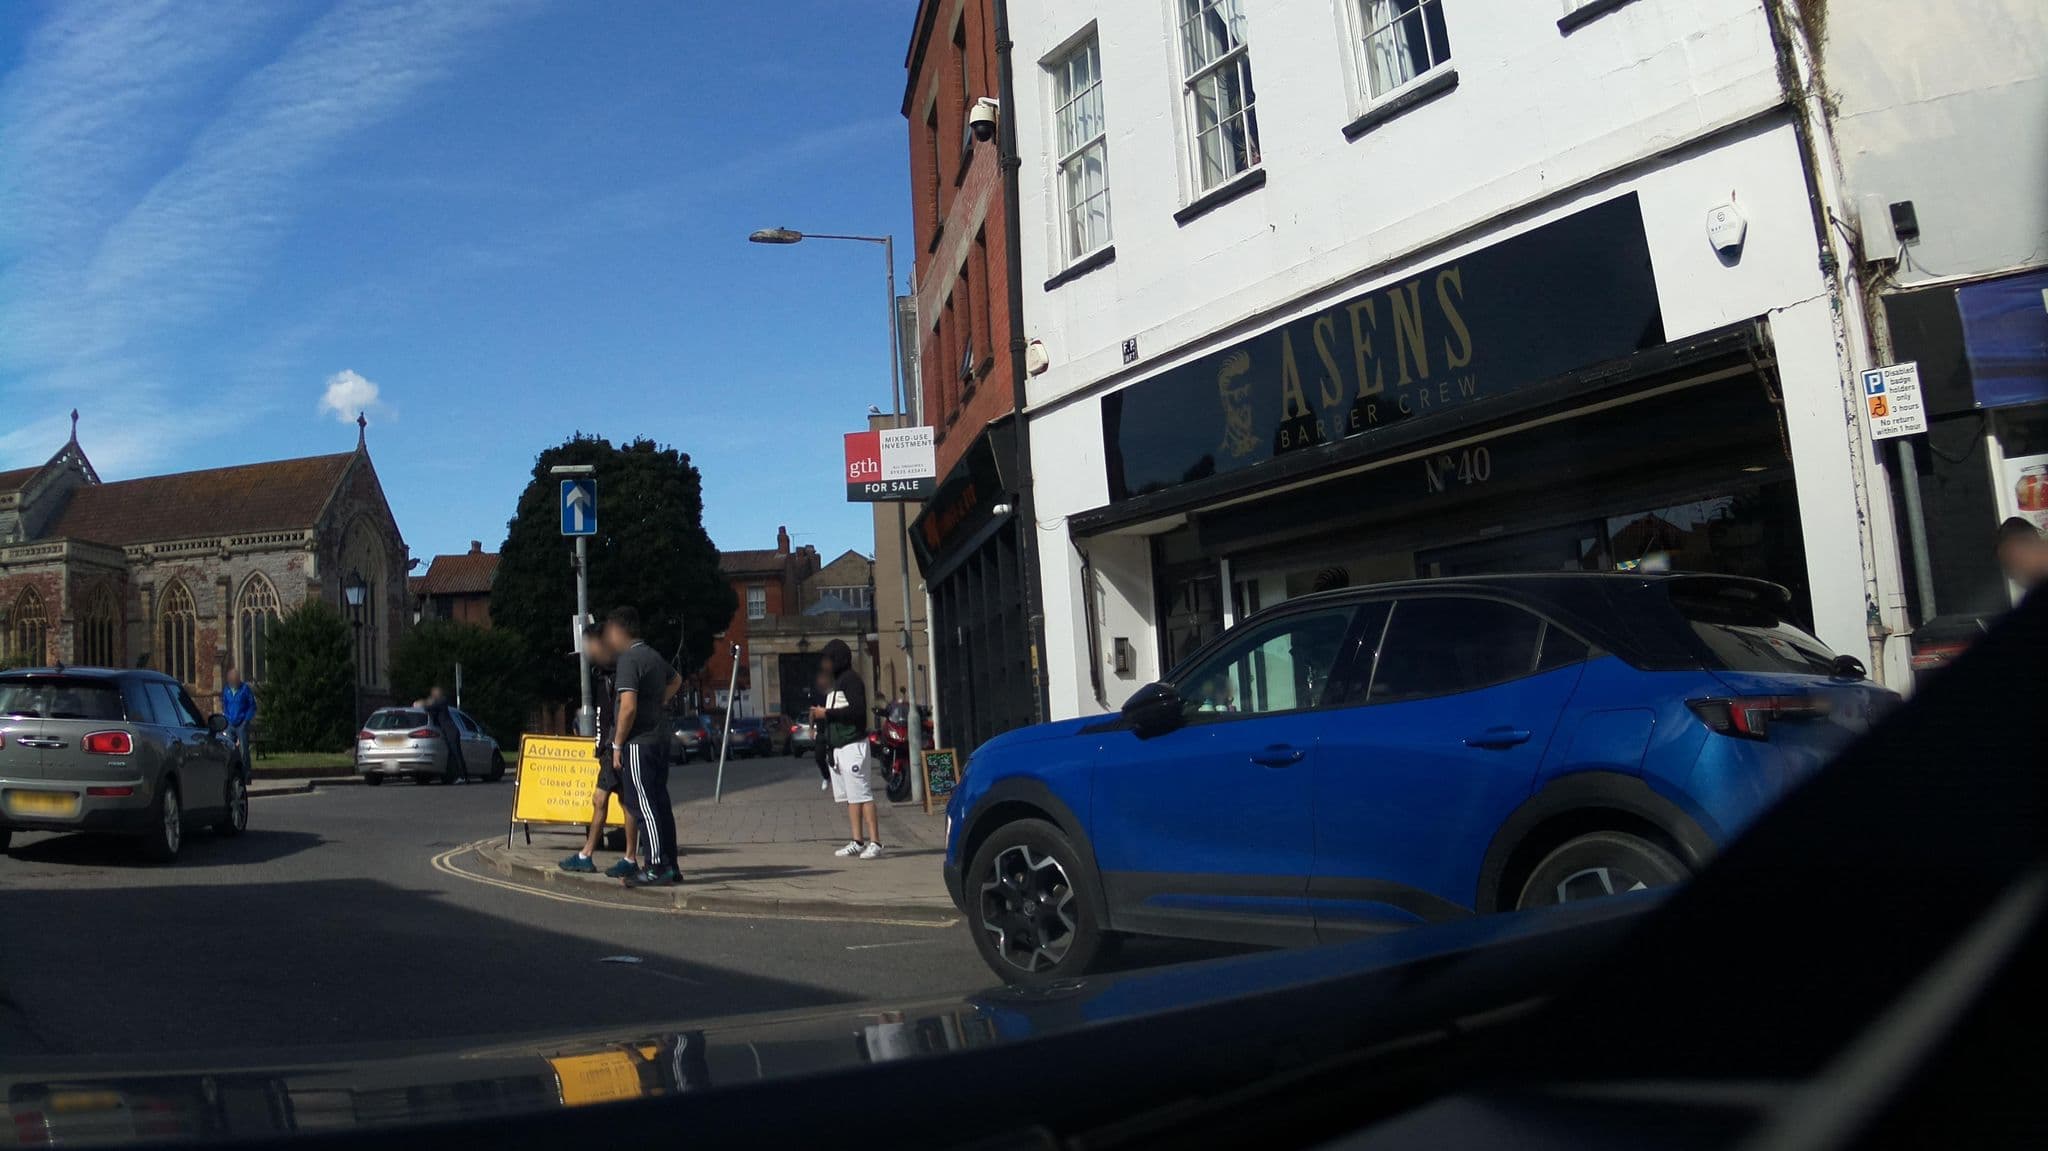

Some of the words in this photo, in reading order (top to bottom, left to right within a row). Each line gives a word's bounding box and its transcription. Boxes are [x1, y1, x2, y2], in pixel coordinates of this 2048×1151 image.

[1280, 266, 1472, 422] ASENS
[1884, 366, 1914, 377] Disabled
[1868, 374, 1881, 393] P
[1890, 376, 1911, 385] badge
[1889, 384, 1915, 393] holders
[1280, 404, 1377, 448] BARBER
[1399, 375, 1476, 414] CREW
[1899, 403, 1919, 411] hours
[1892, 416, 1914, 424] return
[1877, 427, 1897, 435] within
[882, 440, 932, 449] INVESTMENT
[850, 458, 878, 478] gth
[1458, 447, 1491, 484] 40
[865, 483, 887, 493] FOR
[891, 480, 919, 491] SALE
[528, 744, 586, 758] Advance
[529, 763, 566, 773] Cornhill
[570, 765, 576, 773] &
[539, 777, 571, 787] Closed
[576, 780, 586, 788] To
